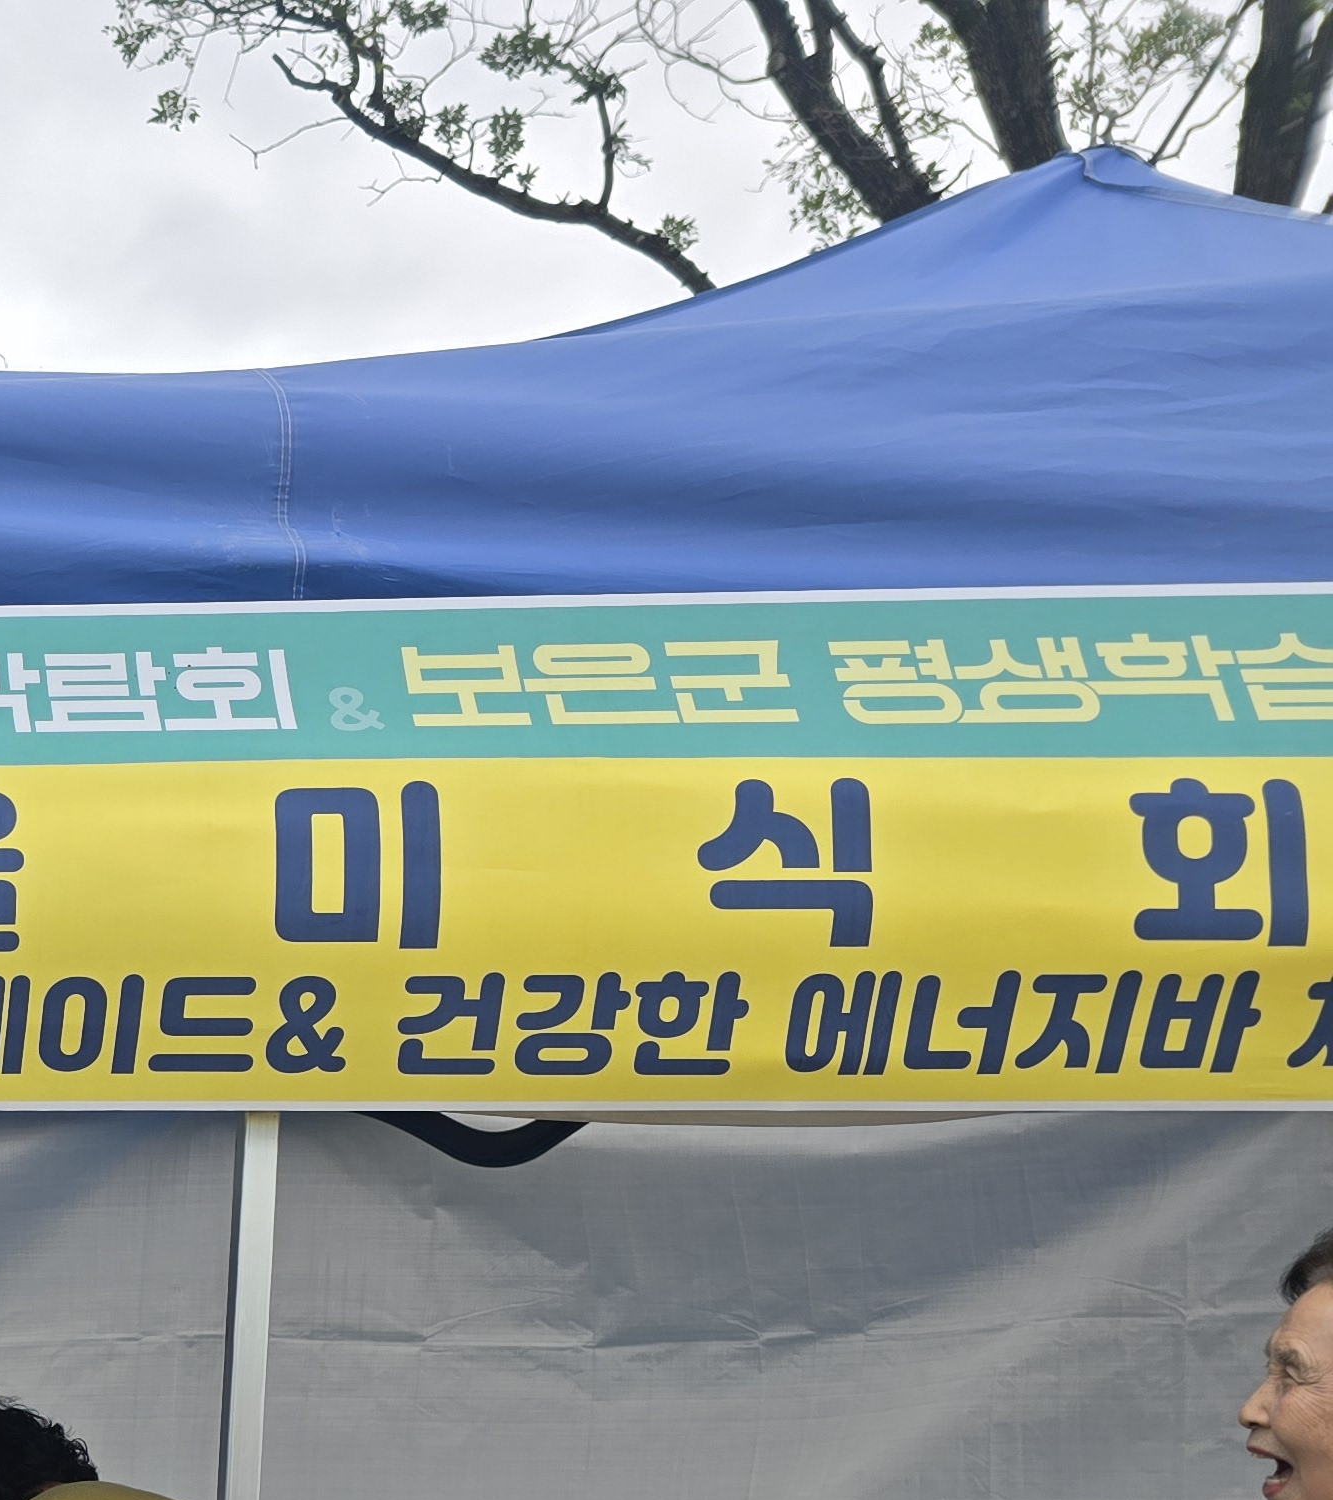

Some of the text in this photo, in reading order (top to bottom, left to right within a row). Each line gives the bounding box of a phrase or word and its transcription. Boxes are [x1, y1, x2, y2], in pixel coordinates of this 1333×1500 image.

[400, 639, 800, 727] 보은군
[832, 632, 1333, 725] 평생학습
[397, 971, 750, 1076] 건강한
[785, 970, 1262, 1076] 에너지바
